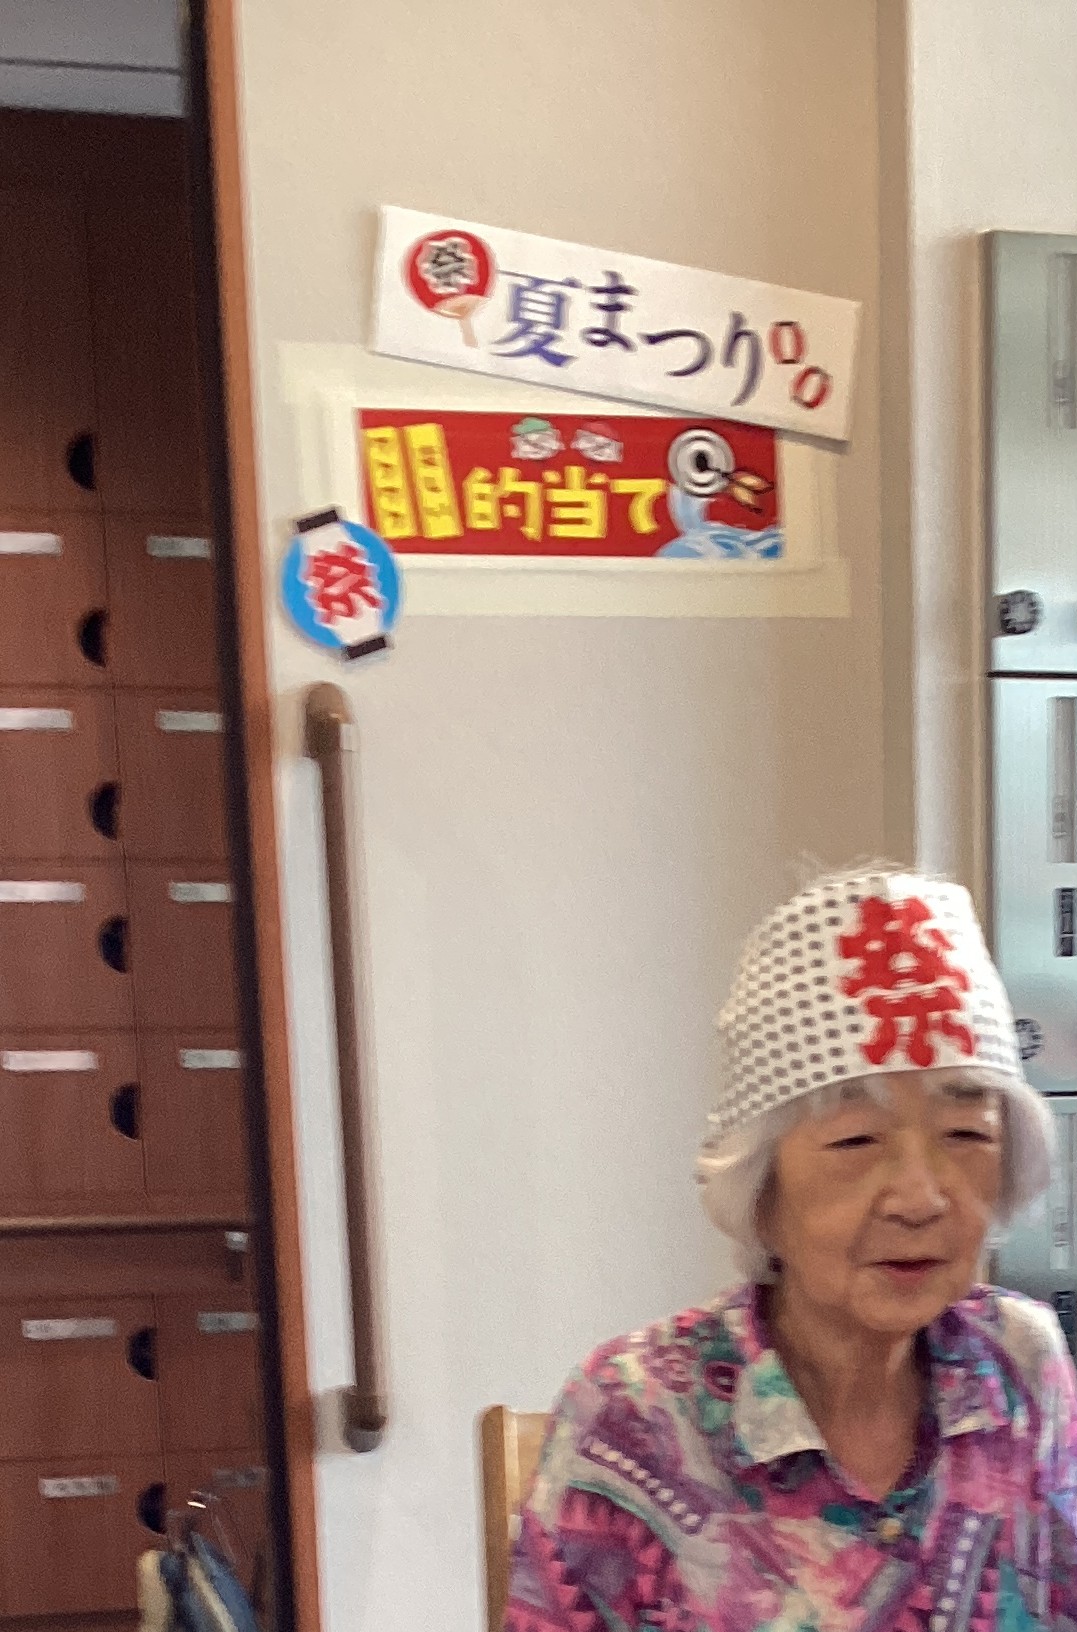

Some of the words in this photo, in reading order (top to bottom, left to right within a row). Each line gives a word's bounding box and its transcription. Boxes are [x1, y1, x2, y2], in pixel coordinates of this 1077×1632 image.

[489, 264, 766, 407] 夏まつり
[463, 465, 669, 541] 的当て
[306, 542, 382, 625] 祭
[836, 895, 973, 1067] 祭
